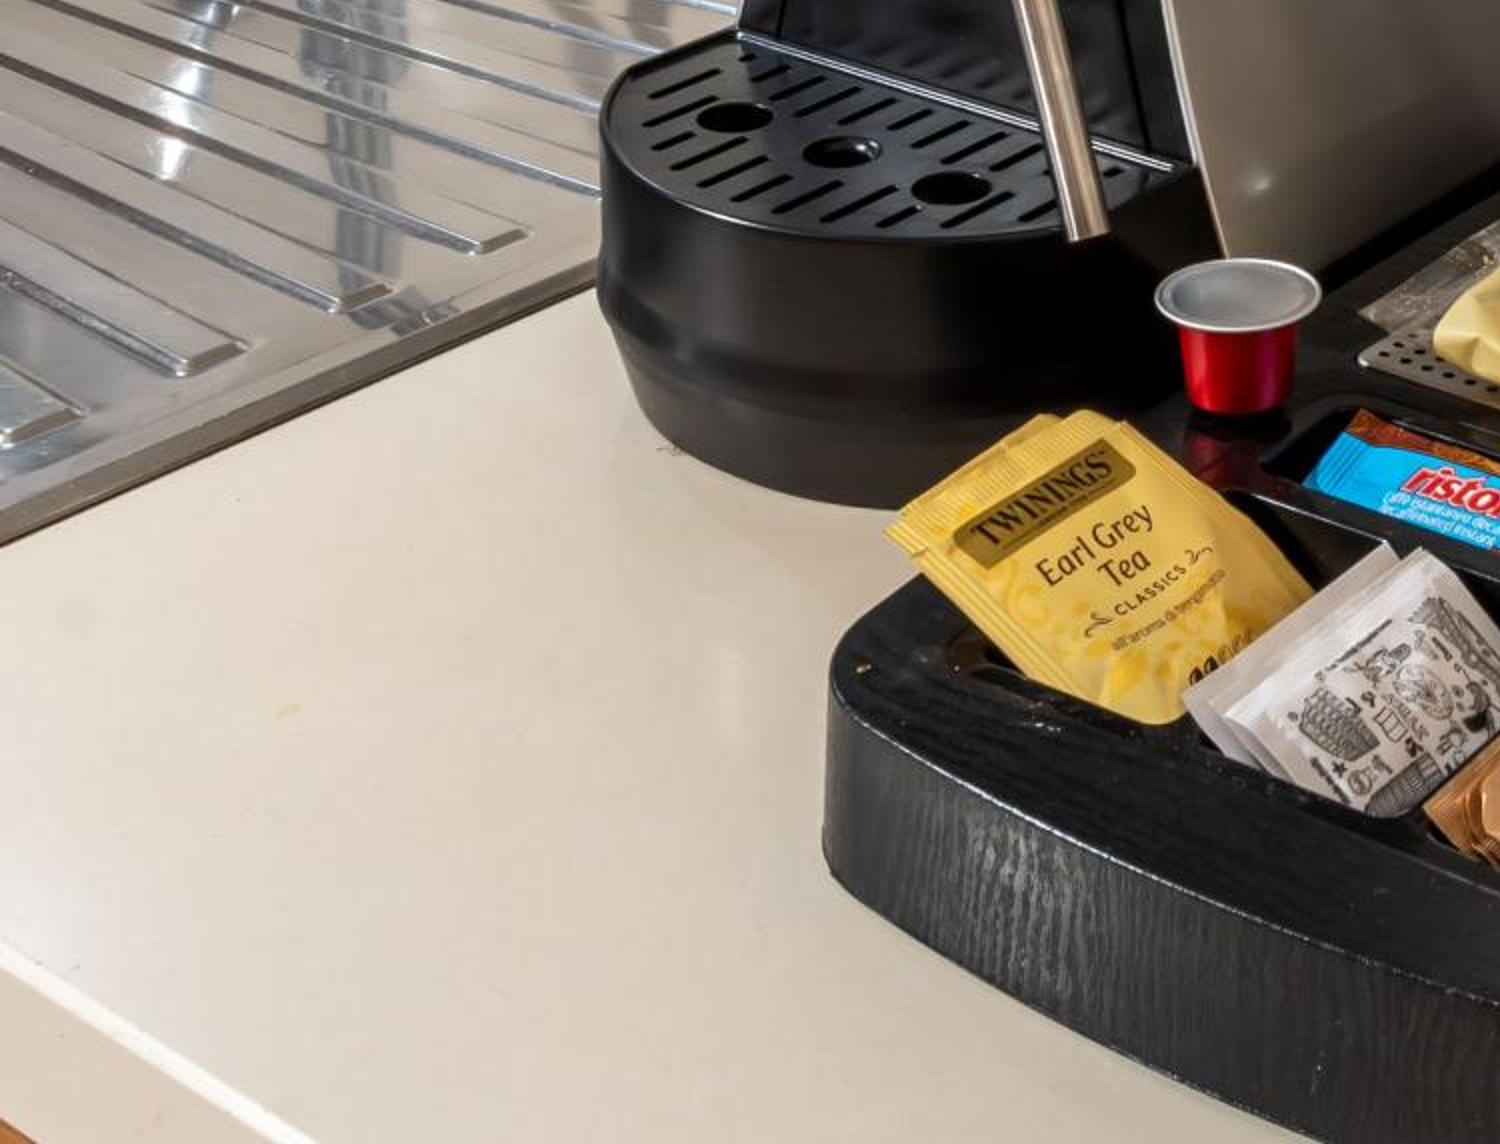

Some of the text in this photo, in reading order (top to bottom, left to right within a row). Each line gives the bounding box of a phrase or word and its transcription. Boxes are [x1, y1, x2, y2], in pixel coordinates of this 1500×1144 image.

[969, 453, 1113, 546] TWININGS
[1034, 535, 1098, 586] Earl
[1091, 504, 1154, 549] Grey
[1096, 550, 1152, 587] Tea
[1113, 564, 1188, 617] CLASSICS
